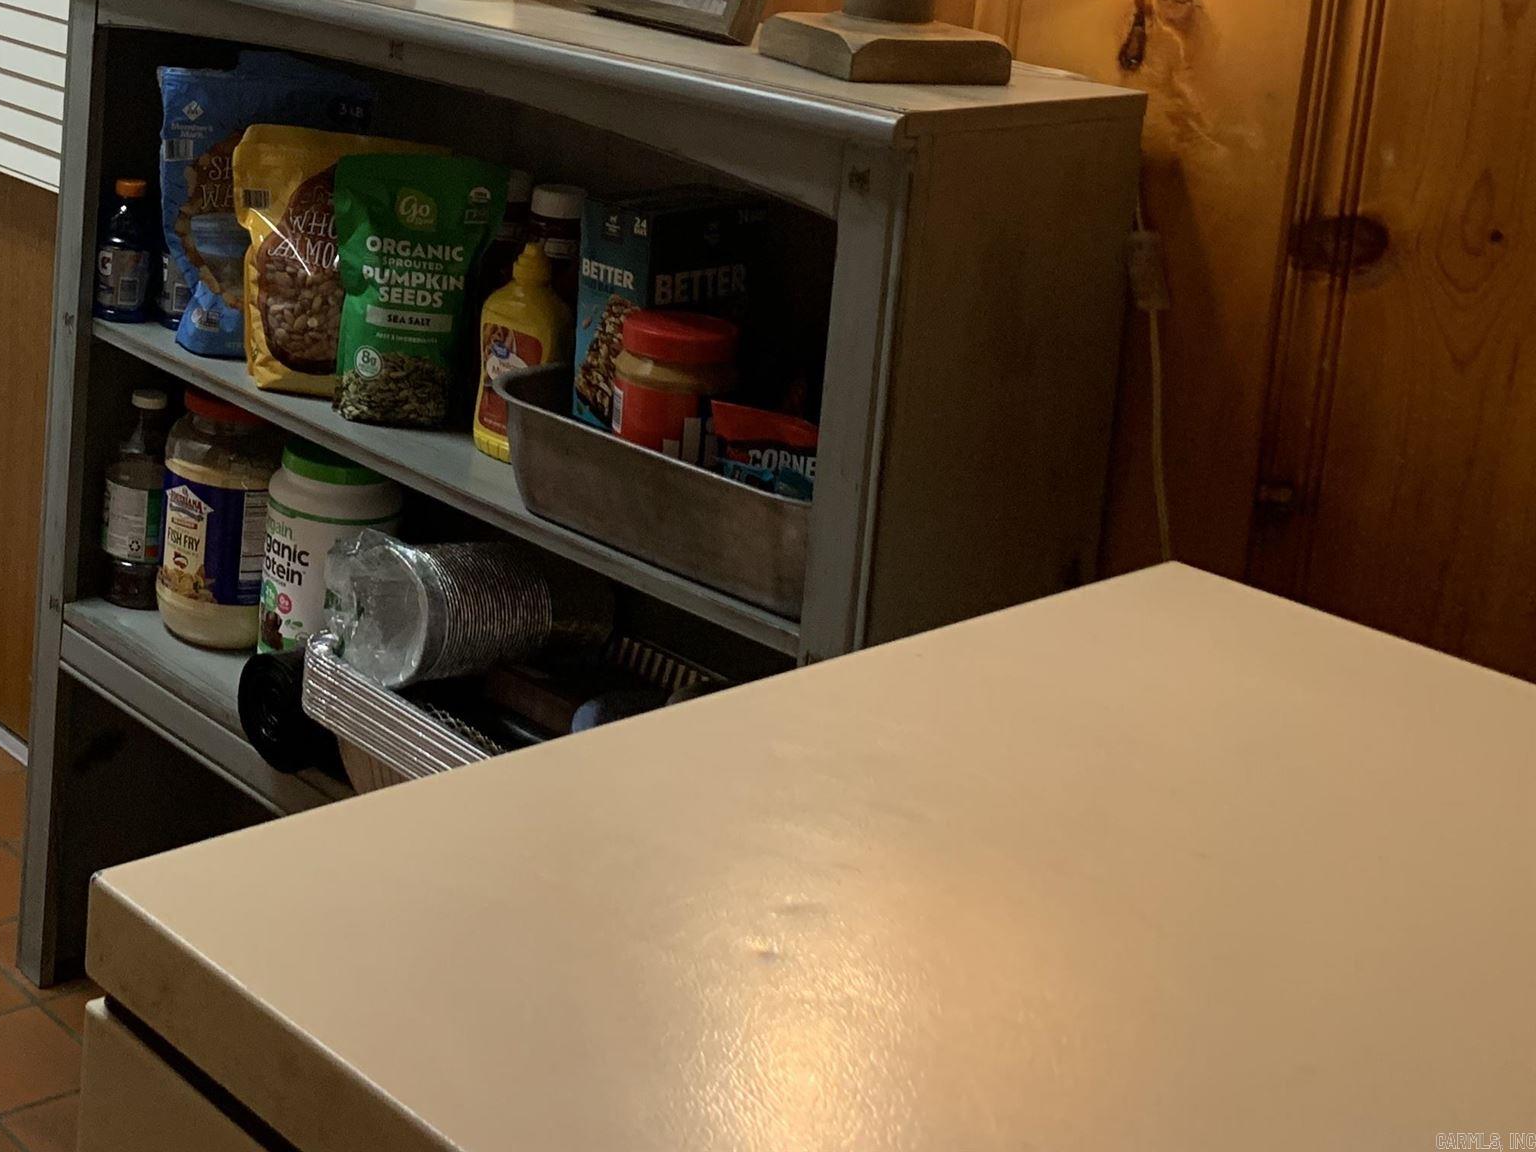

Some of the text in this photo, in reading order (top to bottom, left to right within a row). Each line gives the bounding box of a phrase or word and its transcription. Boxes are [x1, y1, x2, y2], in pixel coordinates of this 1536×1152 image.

[365, 235, 464, 263] ORGANIC
[362, 264, 466, 291] PUMPKIN
[382, 257, 444, 271] SPROUTED
[581, 258, 635, 291] BETTER
[378, 286, 444, 308] SEEDS
[654, 263, 747, 306] BETTER
[387, 314, 432, 327] SEA SALT
[748, 448, 817, 481] CORNE
[168, 527, 201, 552] FISH FRY
[266, 533, 310, 567] ganic
[265, 555, 303, 586] otein
